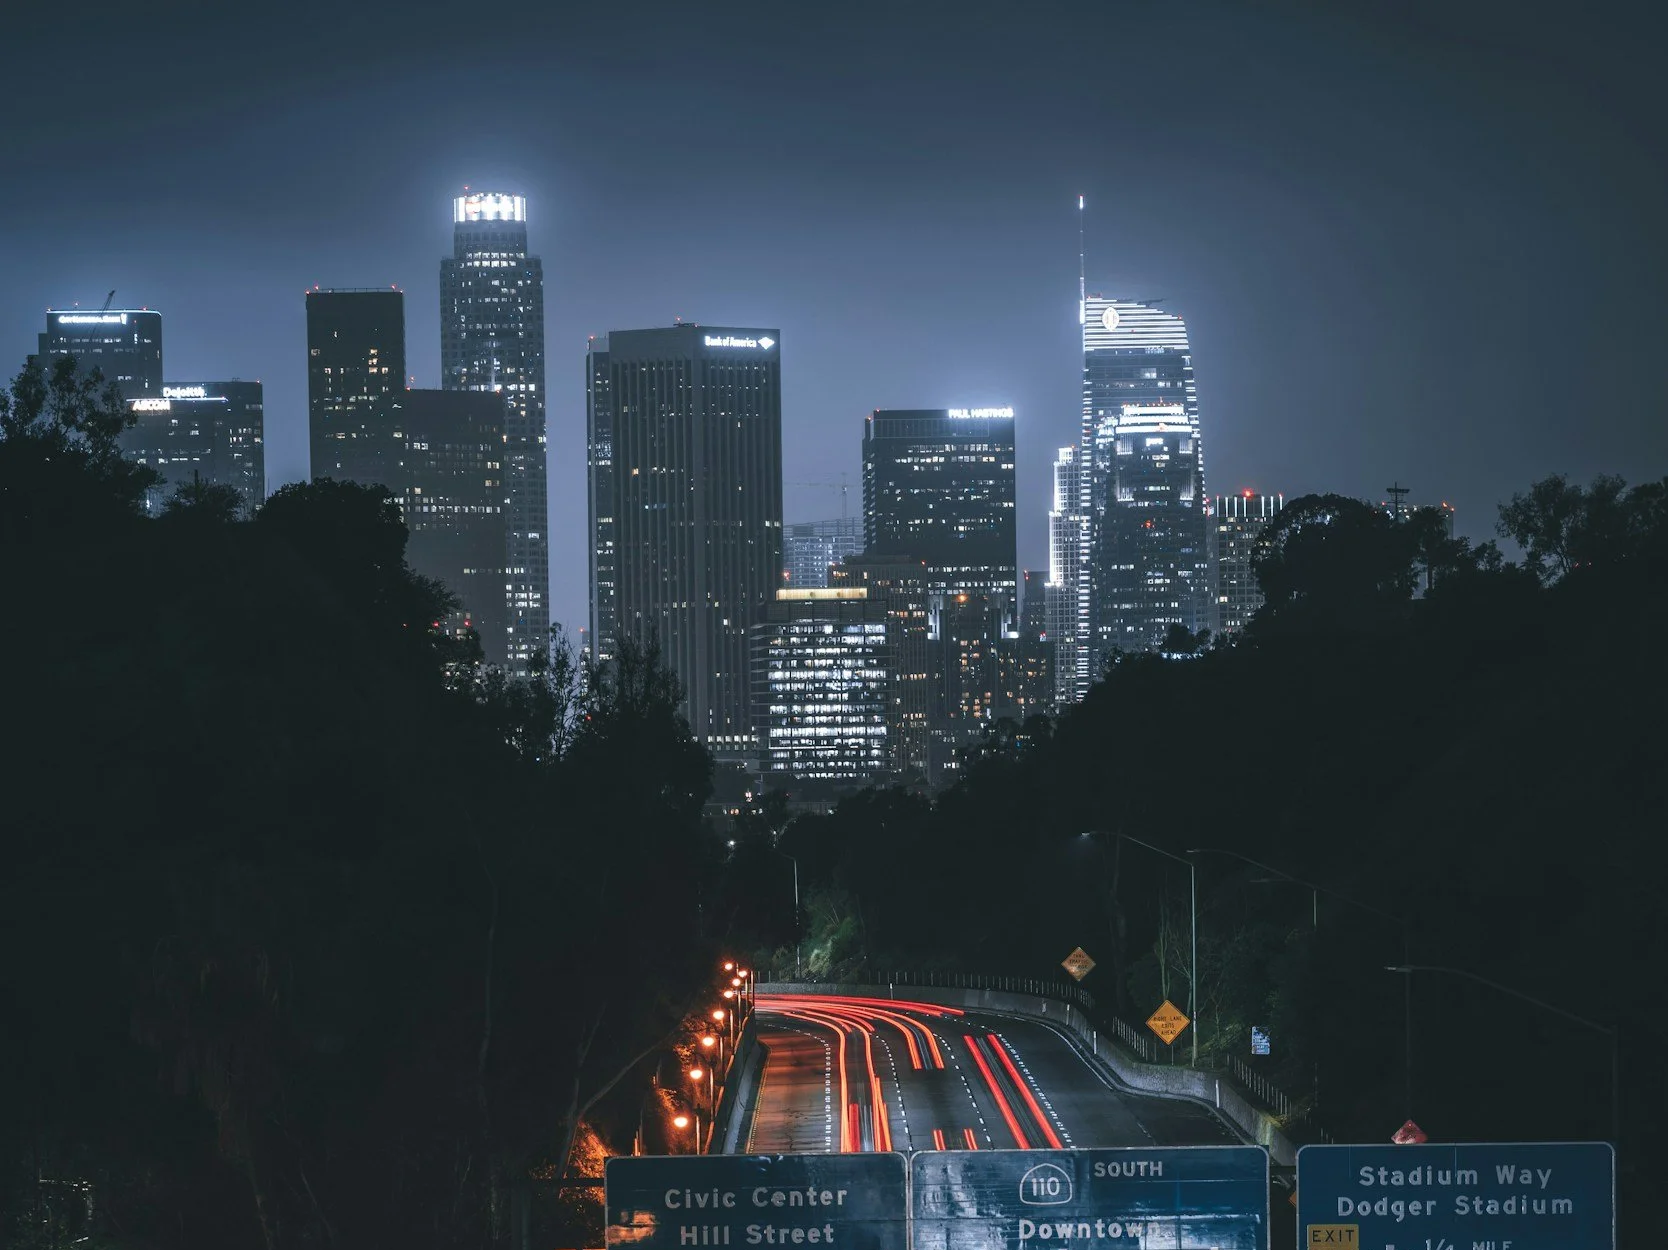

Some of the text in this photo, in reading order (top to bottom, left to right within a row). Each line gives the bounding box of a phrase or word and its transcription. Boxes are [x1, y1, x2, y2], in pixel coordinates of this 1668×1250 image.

[1094, 1161, 1163, 1178] SOUTH
[1358, 1164, 1552, 1189] Stadium Way
[664, 1186, 848, 1209] Civic Center
[1031, 1177, 1060, 1196] 110
[1337, 1195, 1573, 1222] Dodger Stadium
[680, 1223, 835, 1246] Hill Street
[1018, 1218, 1161, 1240] Downtown
[1312, 1230, 1355, 1243] EXIT
